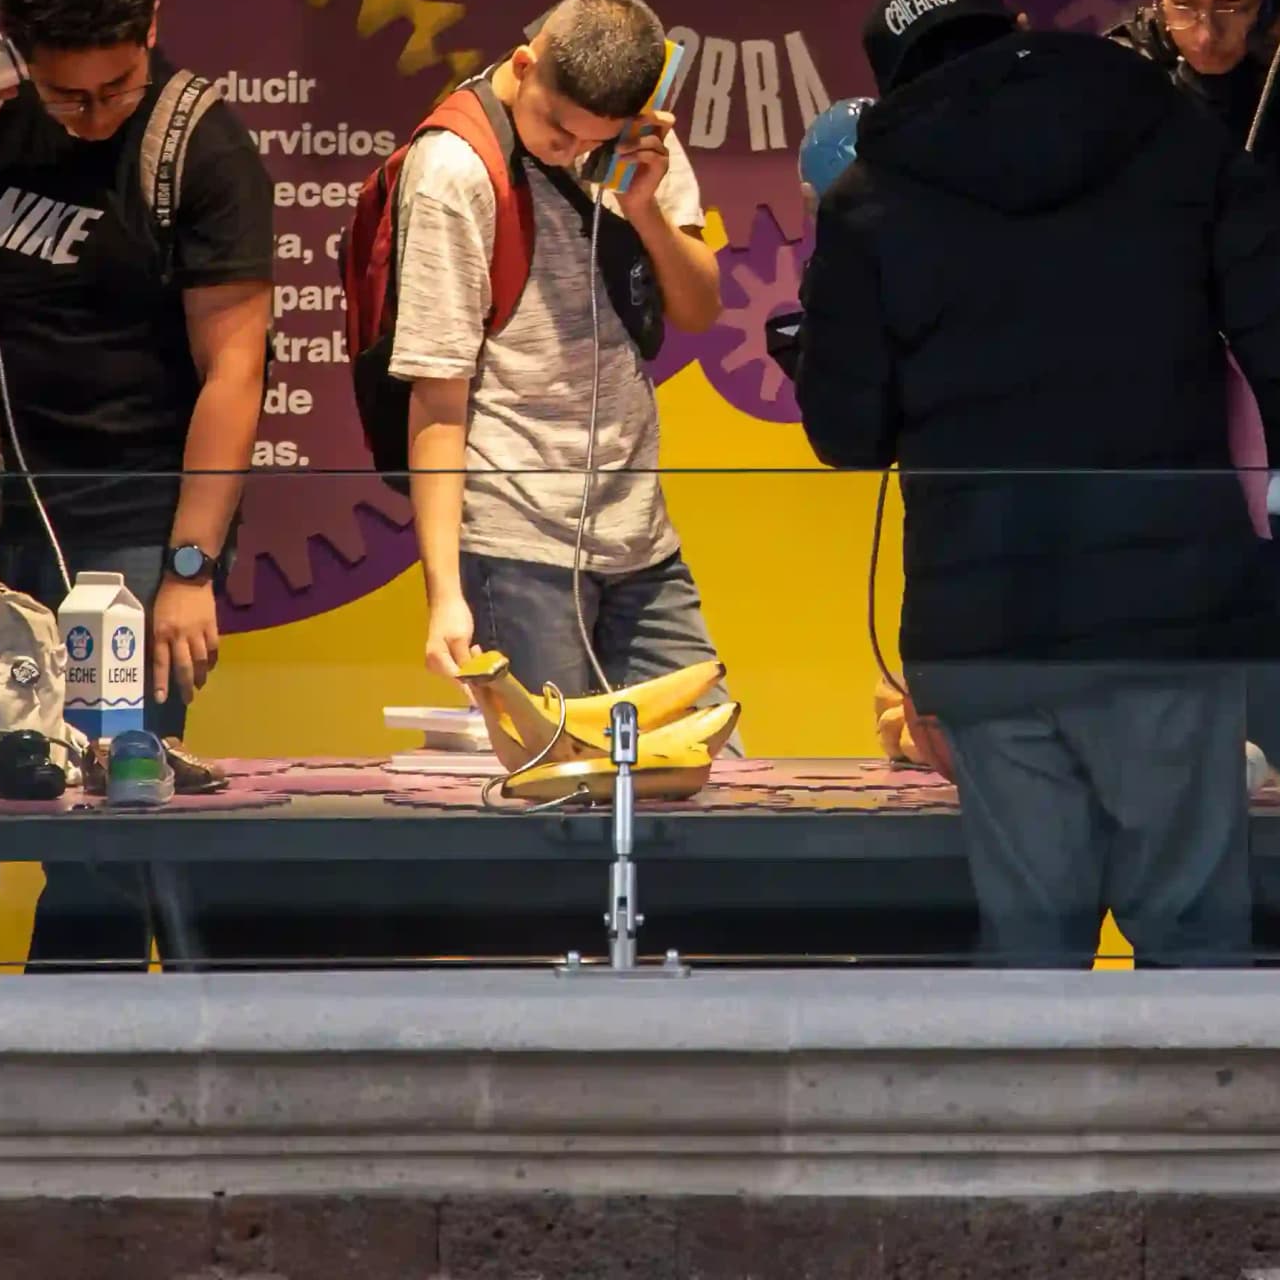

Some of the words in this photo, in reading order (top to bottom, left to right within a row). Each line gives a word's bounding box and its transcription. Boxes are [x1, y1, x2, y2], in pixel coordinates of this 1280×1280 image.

[214, 70, 317, 104] ducir
[248, 122, 397, 156] rvicios
[108, 668, 139, 683] LECHE
